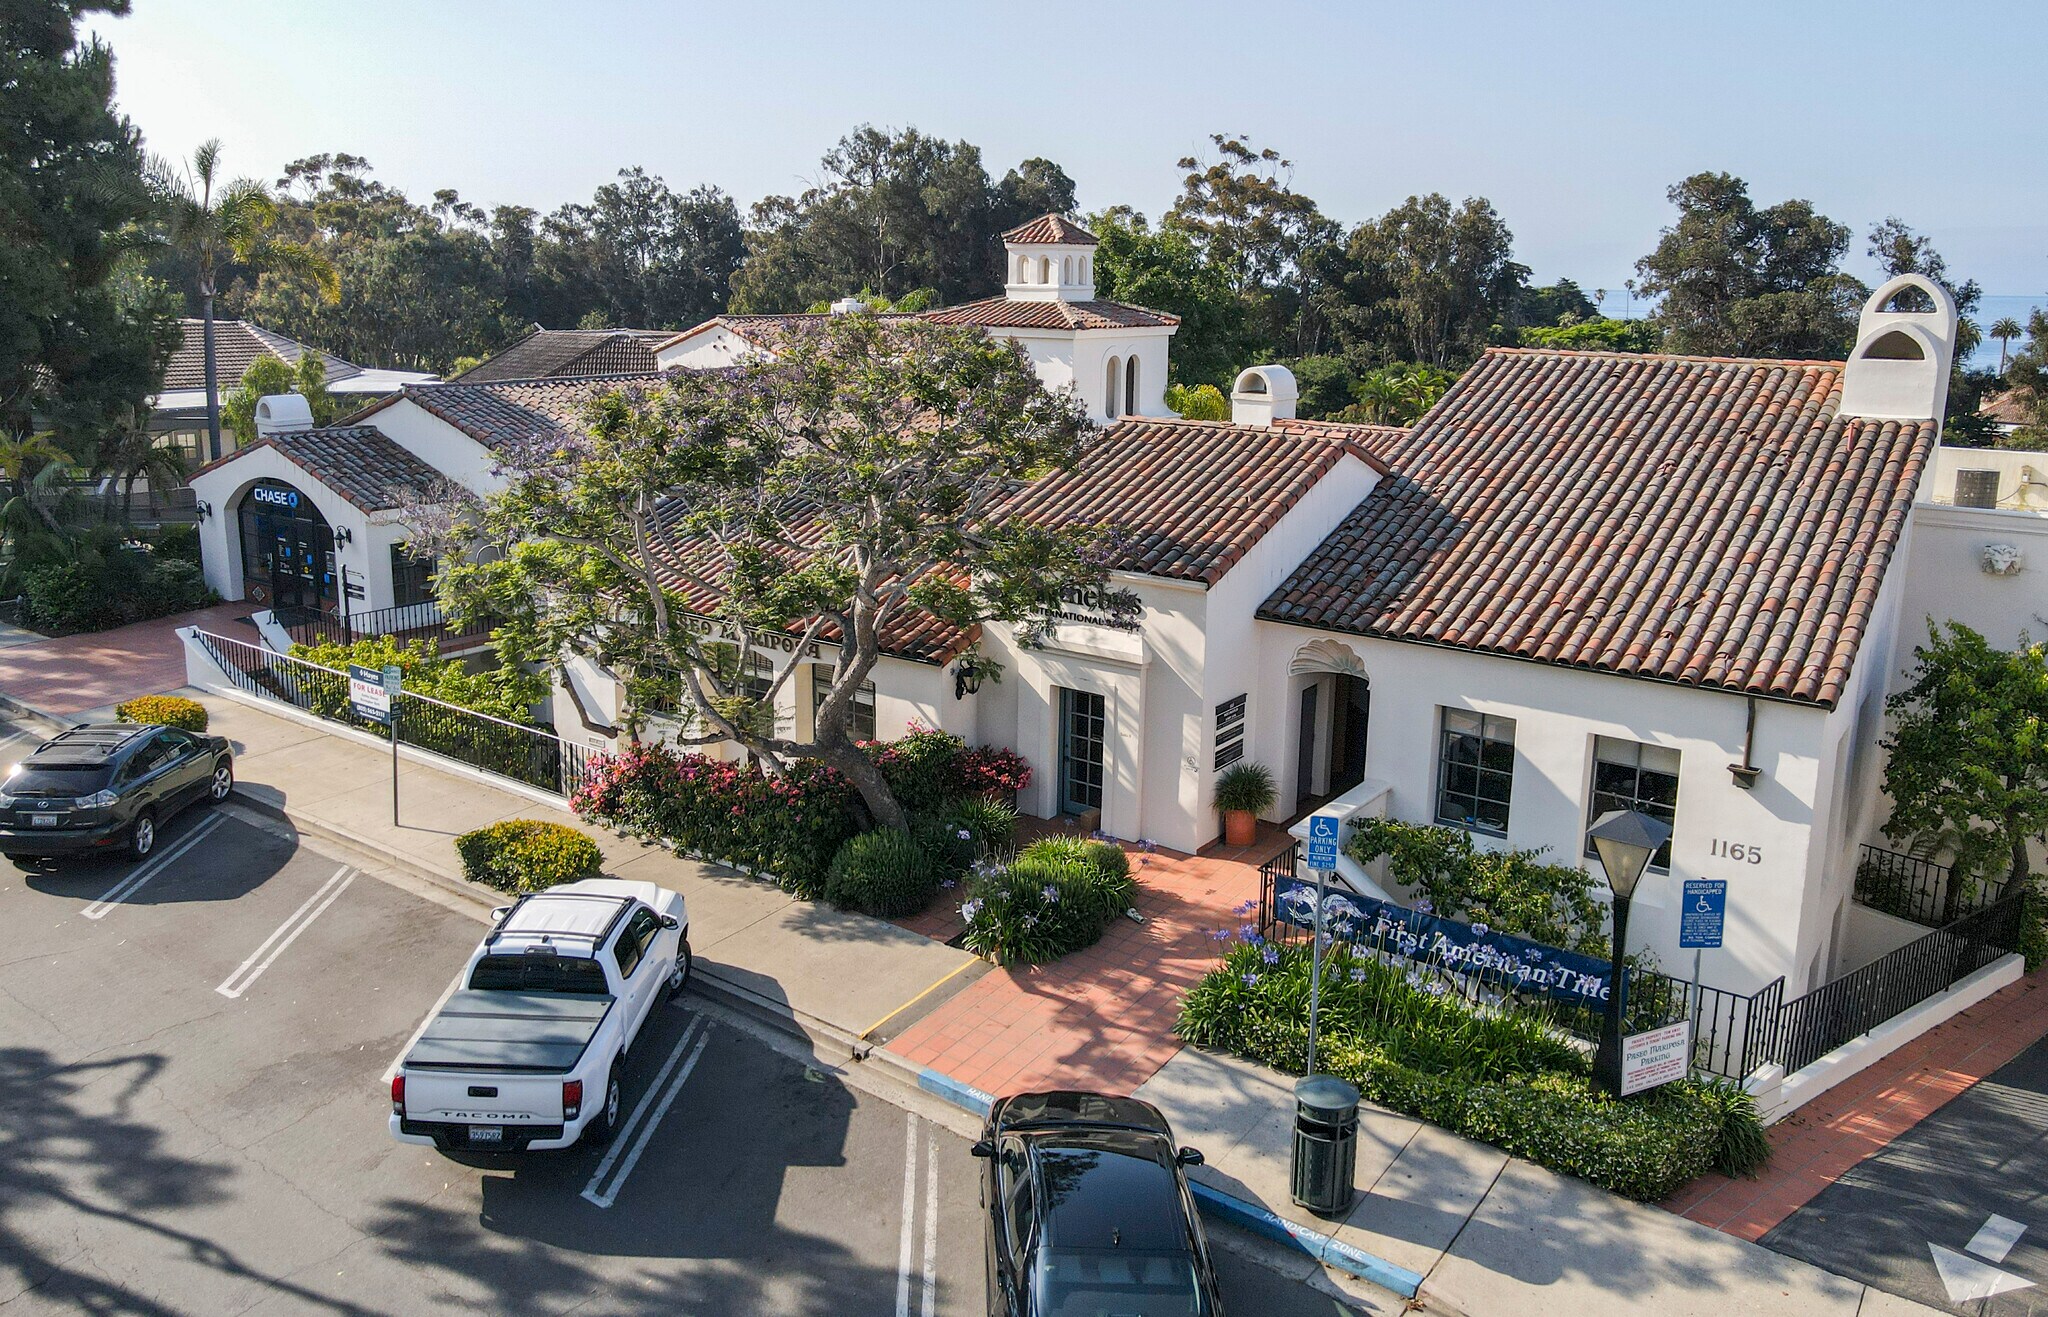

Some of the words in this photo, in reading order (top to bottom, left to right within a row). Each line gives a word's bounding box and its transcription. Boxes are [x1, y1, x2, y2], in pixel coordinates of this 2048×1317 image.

[254, 488, 288, 505] CHASE
[363, 670, 379, 681] Hayes
[353, 682, 366, 691] FOR
[1310, 836, 1337, 847] PARKING
[1314, 845, 1332, 854] ONLY
[1710, 838, 1762, 865] 1165
[1372, 916, 1429, 949] First
[1429, 935, 1547, 984] American
[440, 1111, 531, 1120] TACOMA
[1263, 1212, 1326, 1241] HANDICAP
[1331, 1240, 1367, 1261] ZONE
